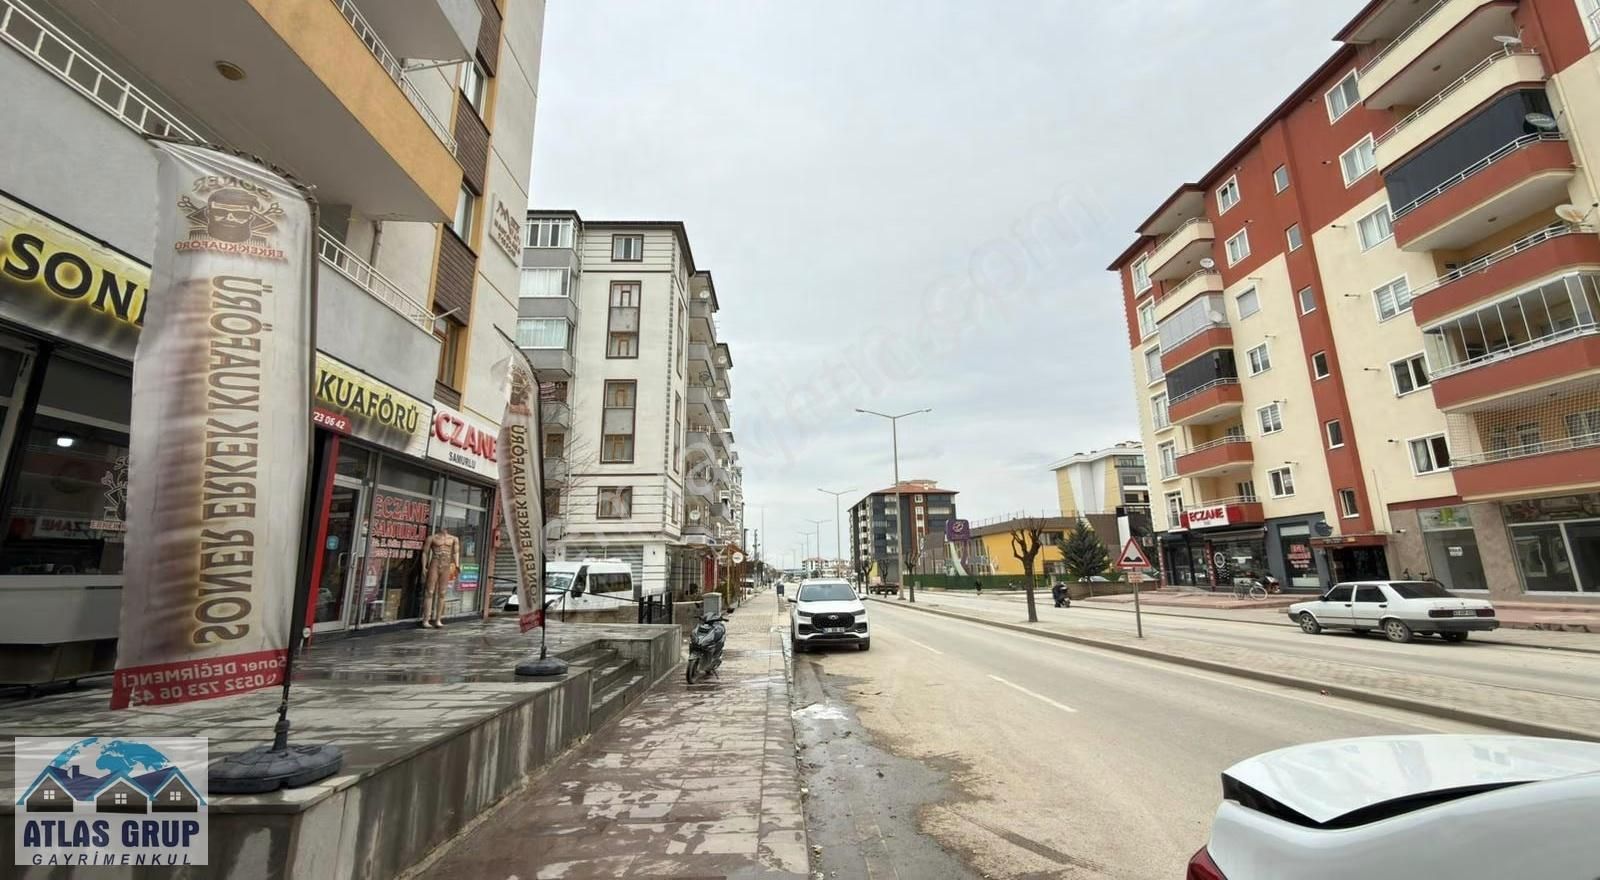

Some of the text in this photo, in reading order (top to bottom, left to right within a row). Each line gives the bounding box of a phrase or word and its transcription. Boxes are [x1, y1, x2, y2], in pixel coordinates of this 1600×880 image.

[3, 233, 148, 327] SON
[313, 411, 346, 430] 23 06 42
[316, 369, 420, 434] KUAFÖRÜ
[430, 410, 497, 463] CZANE
[1189, 507, 1225, 522] ECZANE
